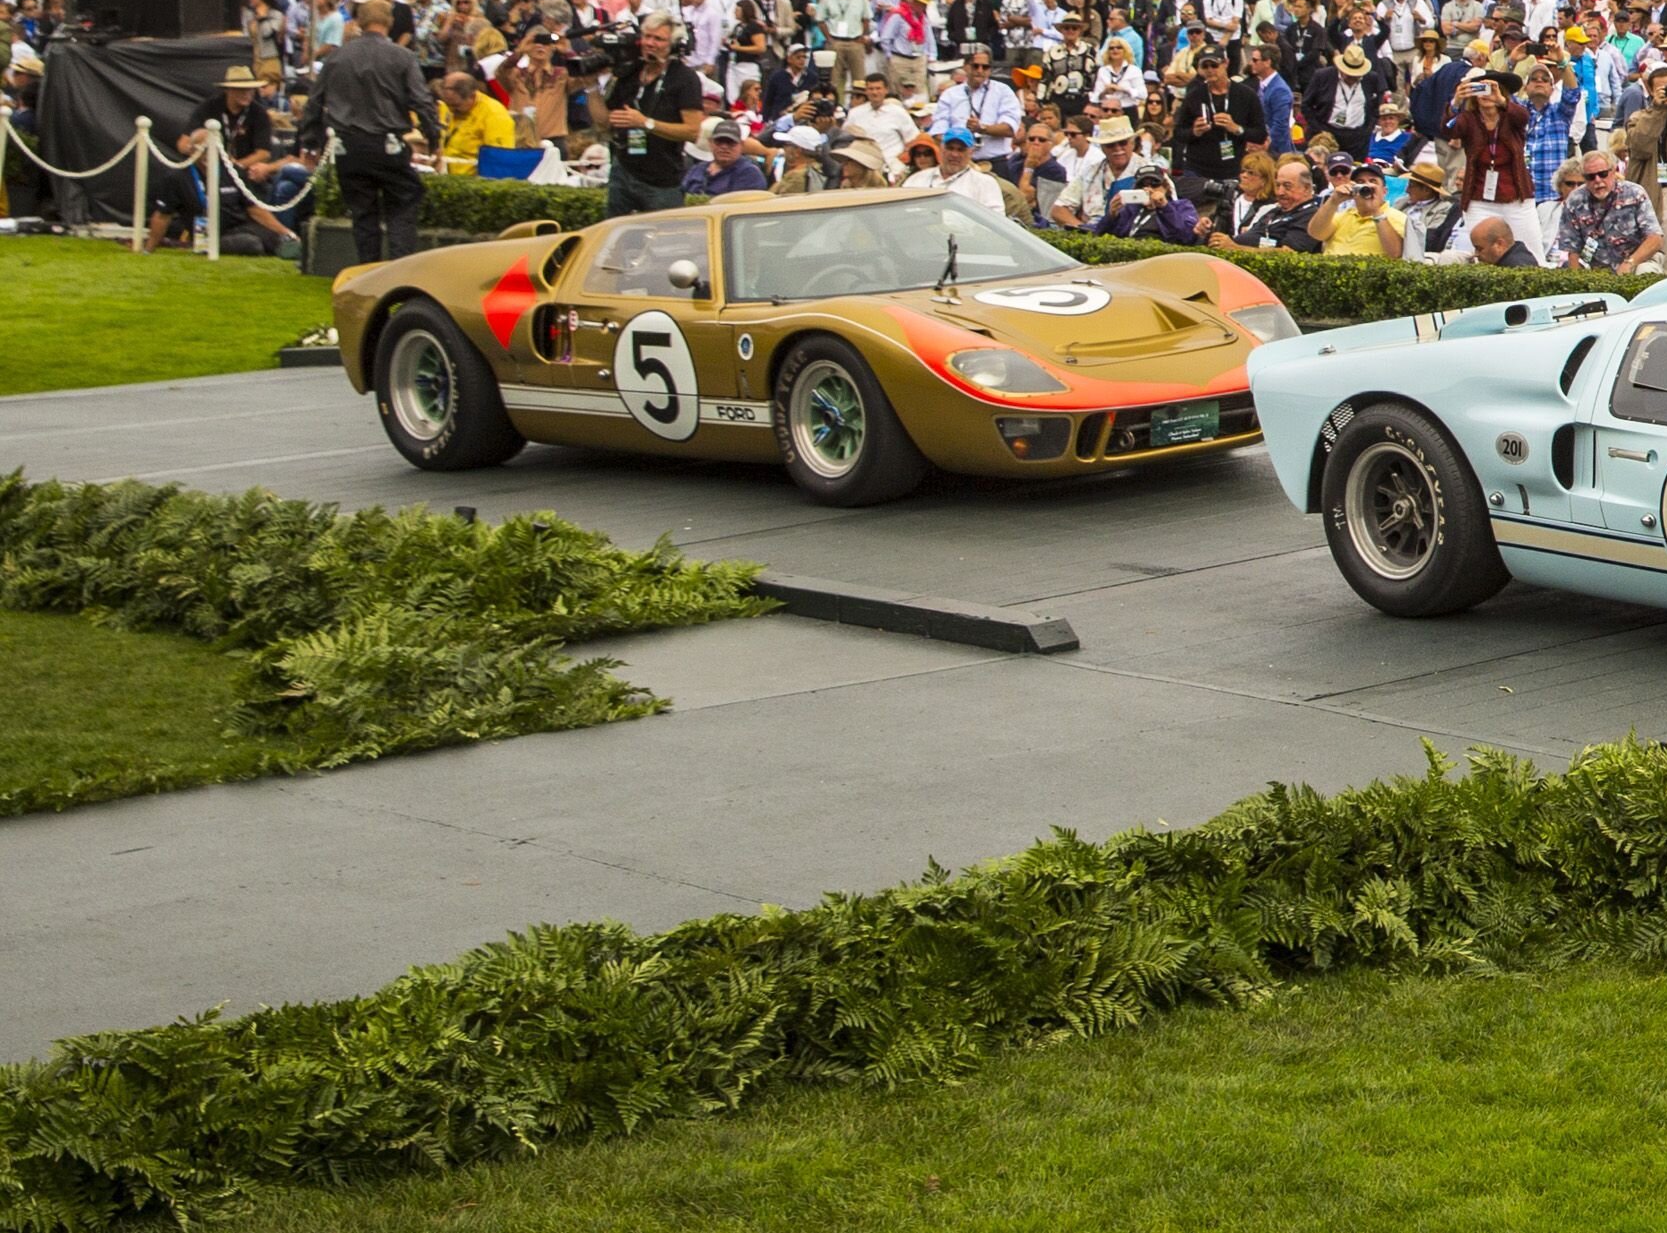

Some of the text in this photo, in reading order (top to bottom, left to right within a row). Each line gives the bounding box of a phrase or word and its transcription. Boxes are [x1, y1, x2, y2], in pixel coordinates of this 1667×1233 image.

[991, 288, 1089, 308] 5
[632, 330, 680, 424] 5
[716, 405, 756, 421] FORD
[1501, 439, 1522, 457] 201
